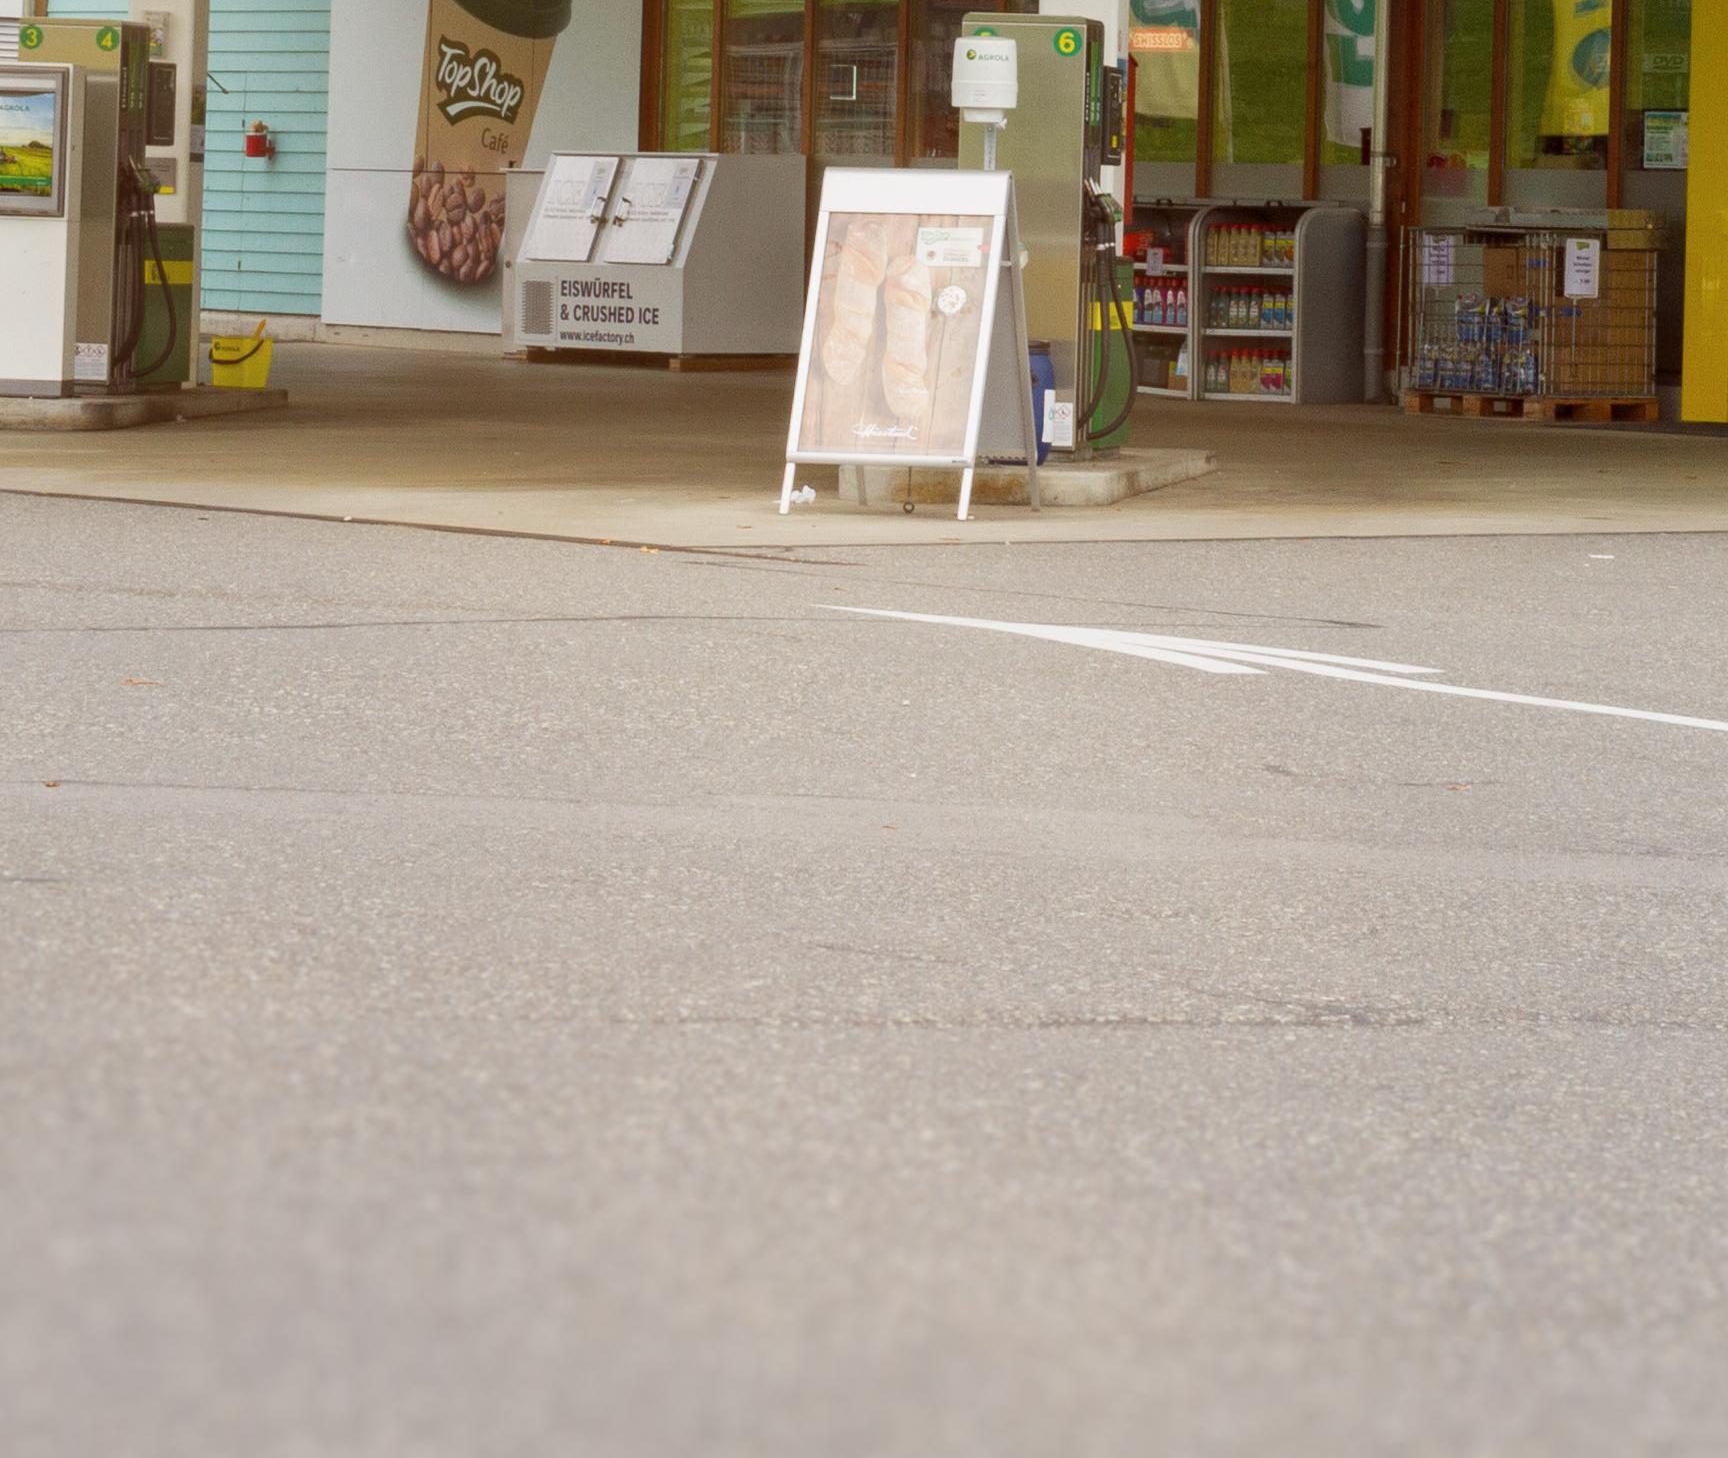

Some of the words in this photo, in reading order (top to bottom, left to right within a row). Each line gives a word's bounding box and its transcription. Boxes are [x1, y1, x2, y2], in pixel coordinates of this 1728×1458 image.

[26, 28, 38, 47] 3
[101, 30, 114, 48] 4
[1058, 31, 1076, 54] 6
[978, 53, 1009, 62] AGROLA
[481, 127, 509, 154] Café
[560, 278, 633, 300] EISWÜRFEL
[560, 304, 569, 320] &
[573, 304, 635, 324] CRUSHED
[638, 308, 660, 325] ICE
[560, 329, 635, 346] www.icefactory.ch
